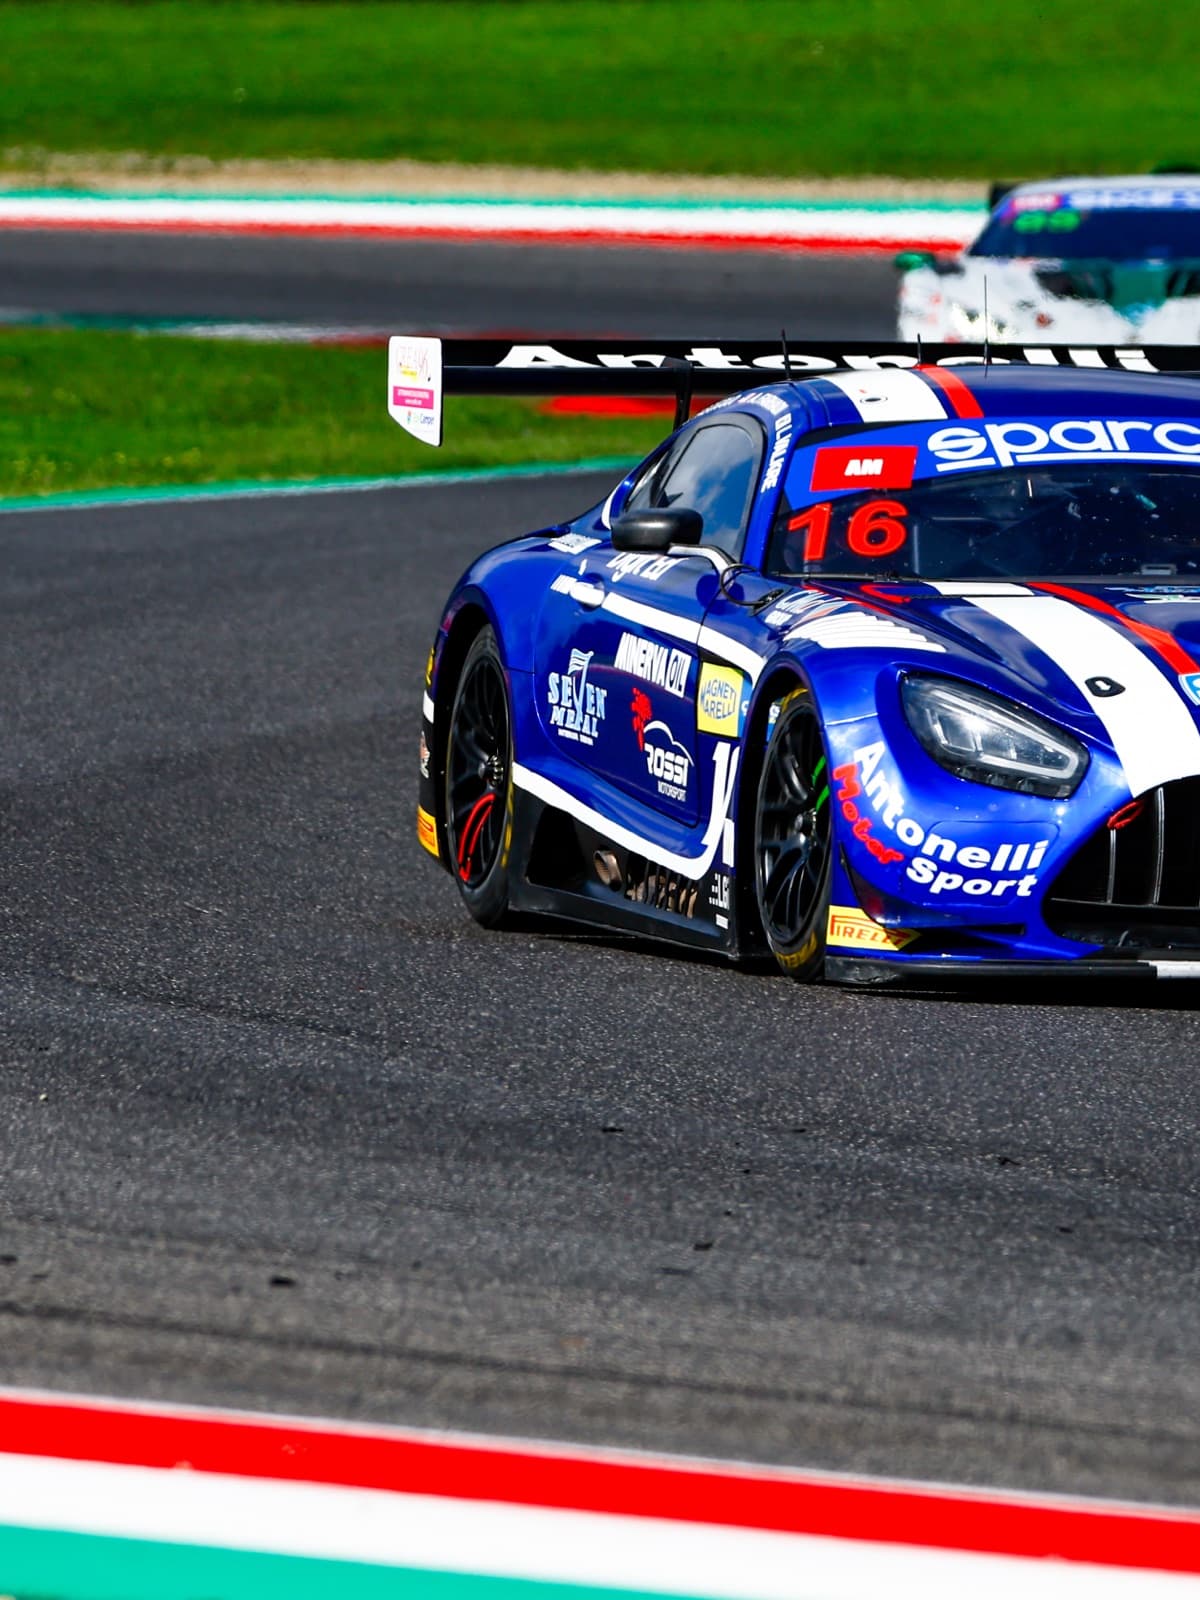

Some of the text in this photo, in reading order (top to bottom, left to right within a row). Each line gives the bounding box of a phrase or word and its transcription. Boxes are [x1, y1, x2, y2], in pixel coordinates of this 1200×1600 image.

[844, 458, 884, 476] AM
[788, 499, 909, 561] 16
[547, 648, 607, 720] SEVEN
[614, 632, 688, 698] MINERVA OIL
[644, 742, 689, 787] ROSSI
[832, 762, 1038, 897] Motor Sport
[853, 740, 1049, 872] Antonelli
